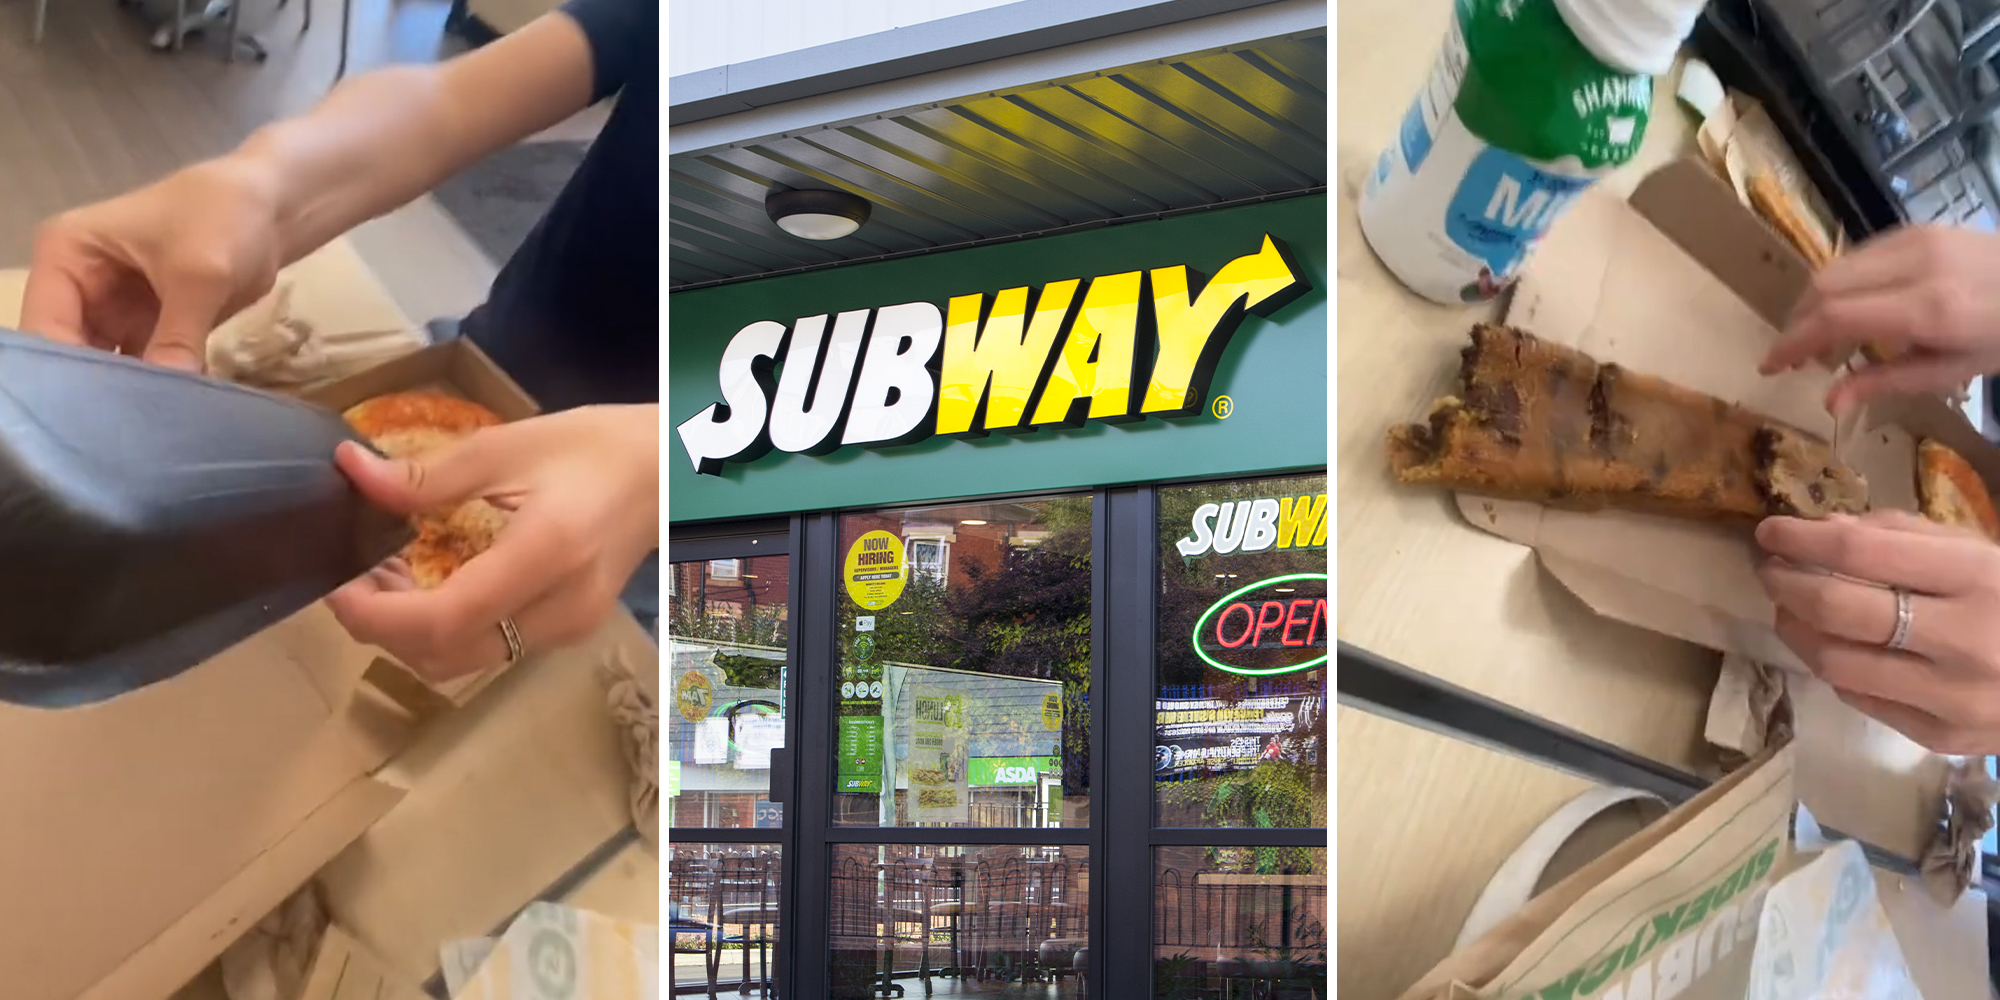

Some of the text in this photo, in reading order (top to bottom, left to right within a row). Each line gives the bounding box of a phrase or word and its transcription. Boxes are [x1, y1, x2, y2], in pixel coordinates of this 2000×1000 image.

[676, 231, 1298, 474] SUBWAY
[863, 537, 889, 551] NOW
[858, 551, 894, 566] HIRING
[995, 766, 1037, 783] ASDA
[847, 780, 873, 788] SUBWAY
